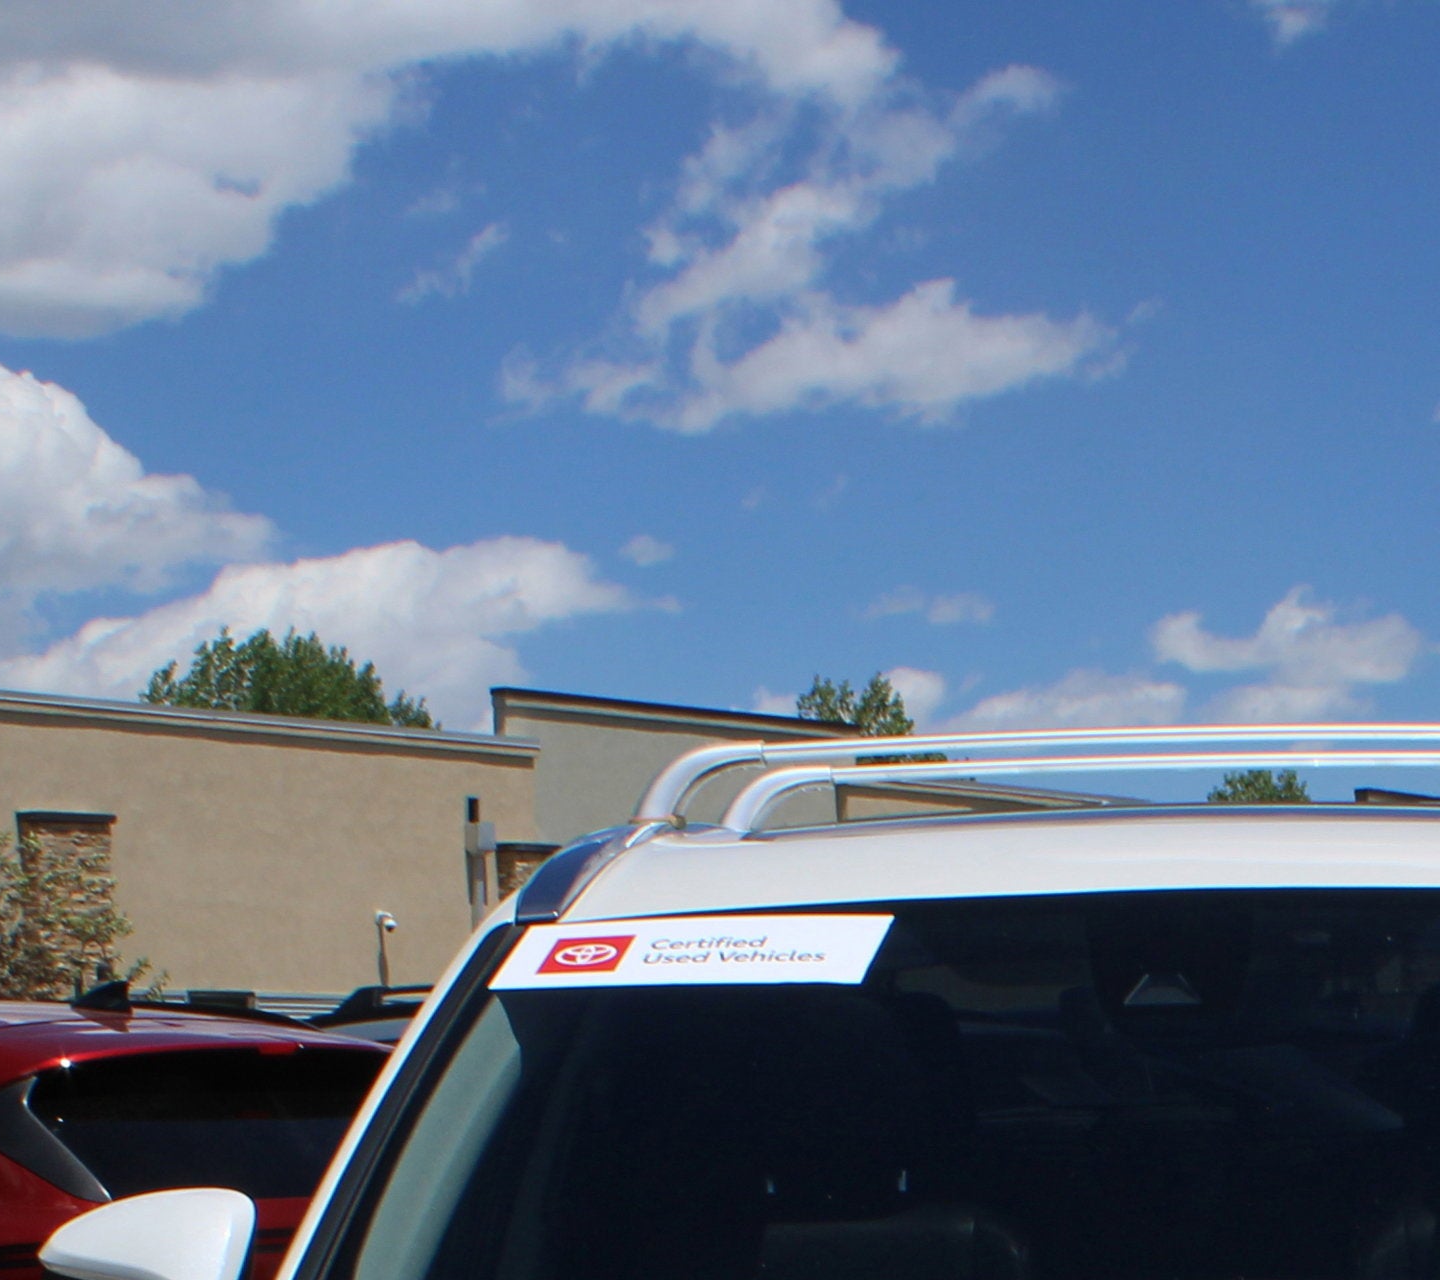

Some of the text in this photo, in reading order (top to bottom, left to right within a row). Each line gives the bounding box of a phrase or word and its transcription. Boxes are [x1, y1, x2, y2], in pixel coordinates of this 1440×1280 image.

[650, 936, 768, 951] Certified
[643, 949, 827, 965] Used Vehicles
